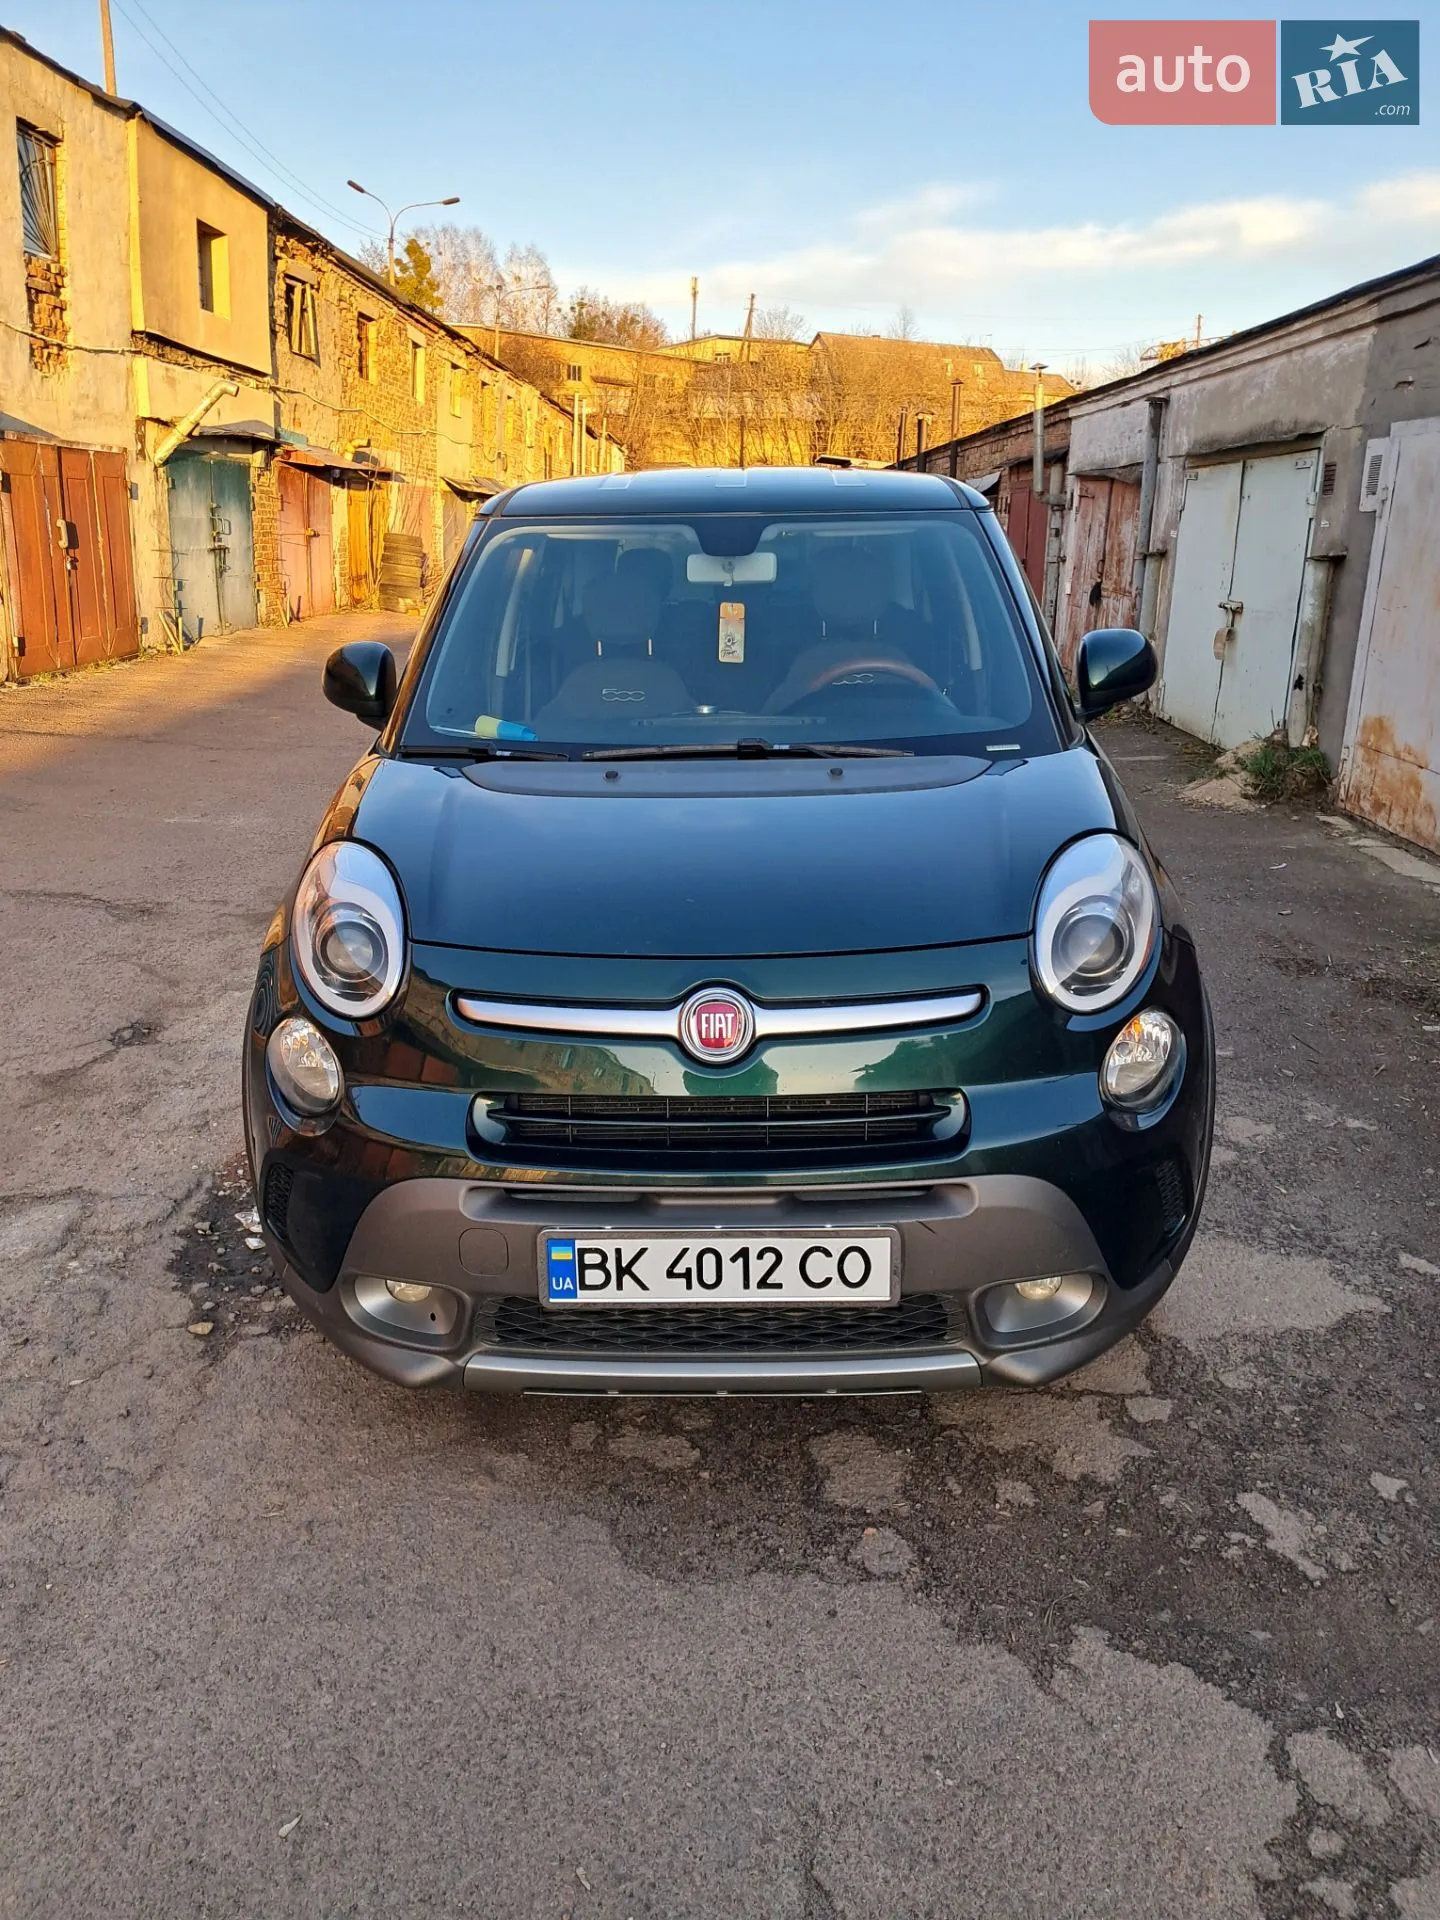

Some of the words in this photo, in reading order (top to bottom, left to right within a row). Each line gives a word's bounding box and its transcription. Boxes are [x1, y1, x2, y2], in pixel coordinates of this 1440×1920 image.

[602, 688, 646, 702] 500
[701, 1013, 735, 1039] FIAT
[577, 1246, 650, 1292] BK
[665, 1245, 784, 1291] 4012
[798, 1244, 873, 1290] CO
[551, 1276, 574, 1291] UA
